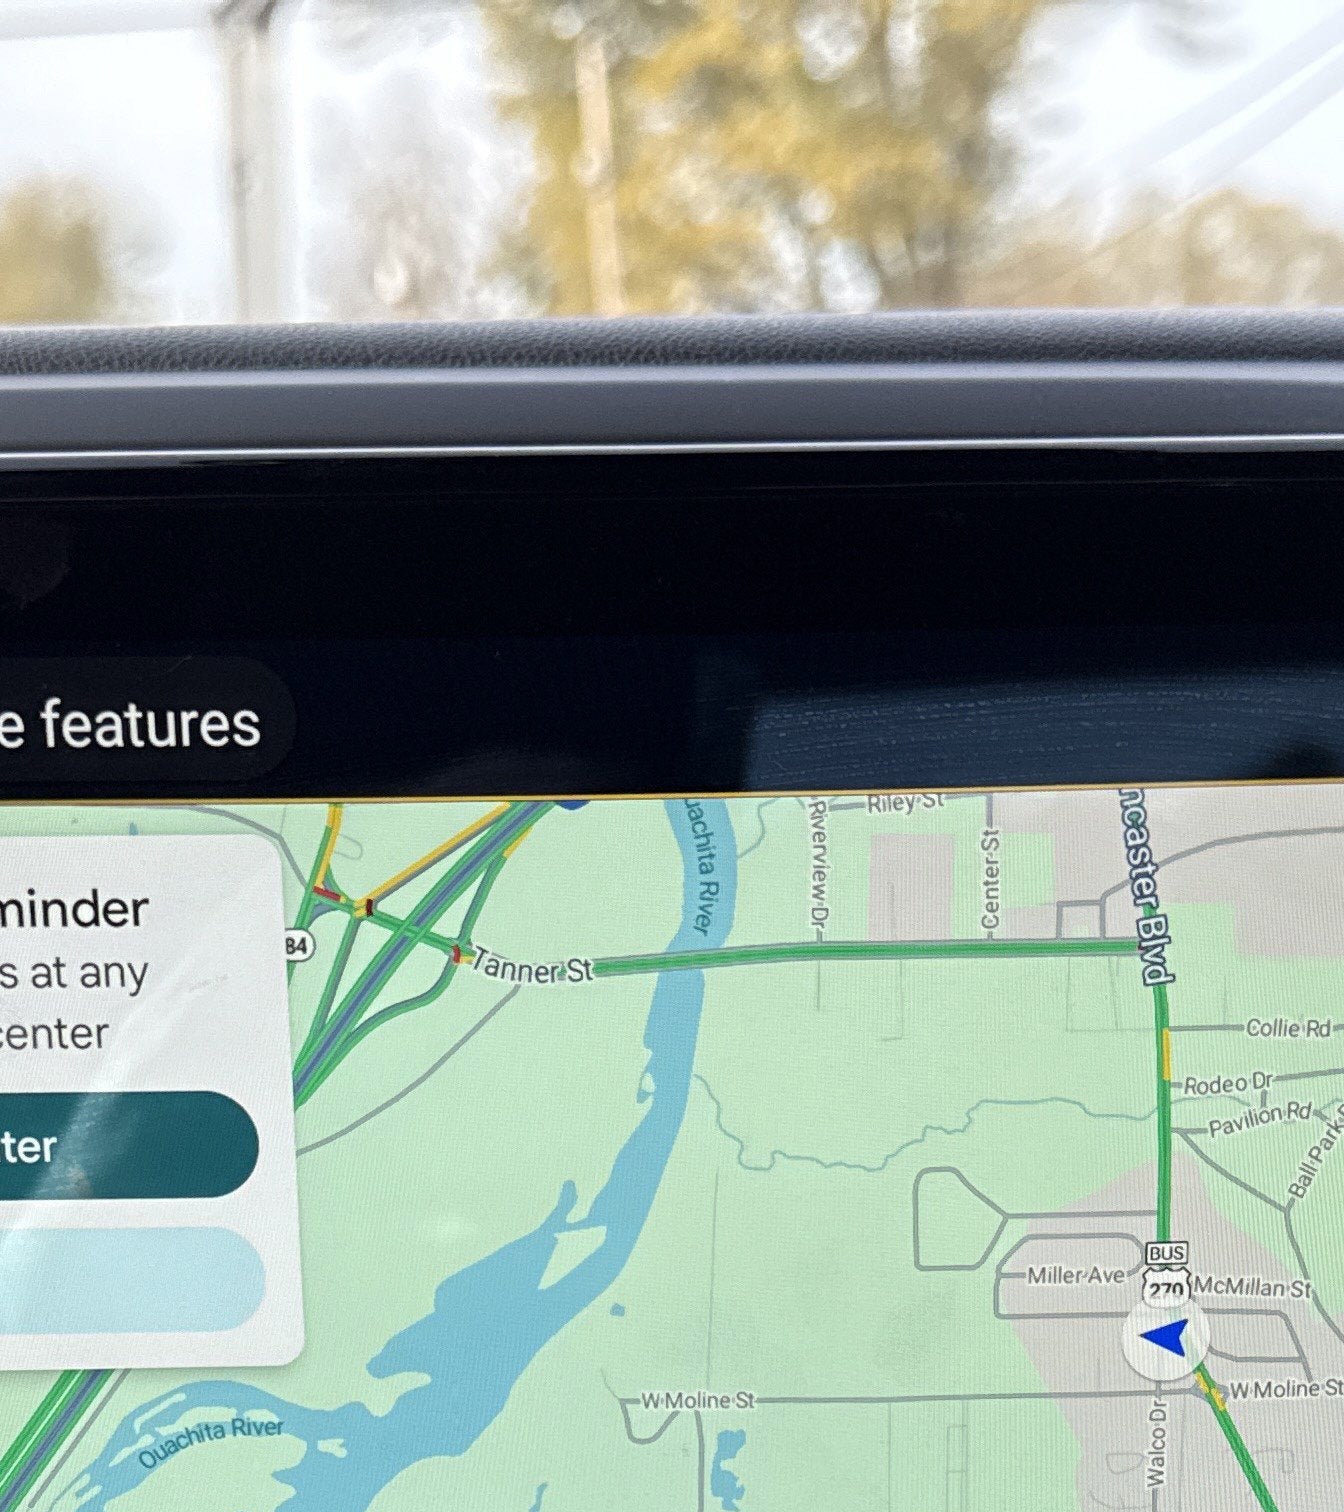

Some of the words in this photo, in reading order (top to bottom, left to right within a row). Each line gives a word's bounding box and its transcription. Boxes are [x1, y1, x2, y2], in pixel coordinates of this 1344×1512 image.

[39, 696, 262, 750] features
[868, 794, 916, 815] Riley
[922, 794, 944, 808] St
[809, 801, 830, 902] Riverview
[982, 829, 1000, 853] St
[981, 854, 1000, 930] Center
[694, 881, 720, 937] River
[812, 907, 829, 929] Dr
[1137, 914, 1176, 986] Blvd
[472, 946, 559, 984] Tanner
[566, 958, 594, 983] St
[30, 957, 68, 990] at
[78, 960, 150, 1001] any
[1246, 1018, 1300, 1038] Collie
[1306, 1018, 1331, 1038] Rd
[1184, 1074, 1246, 1095] Rodeo
[1252, 1071, 1273, 1090] Dr
[1209, 1102, 1283, 1138] Pavilion
[1286, 1101, 1313, 1120] Rd
[1288, 1162, 1318, 1200] Ball
[1149, 1245, 1185, 1261] BUS
[1027, 1266, 1081, 1286] Miller
[1087, 1267, 1126, 1285] Ave
[1194, 1275, 1285, 1298] McMillan
[1290, 1279, 1313, 1300] St
[1149, 1282, 1184, 1299] 270
[641, 1392, 662, 1410] W
[665, 1391, 731, 1410] Moline
[736, 1391, 756, 1409] St
[1229, 1382, 1250, 1400] W
[1254, 1380, 1321, 1399] Moline
[1149, 1401, 1167, 1423] Dr
[137, 1420, 228, 1471] Ouachita
[231, 1416, 285, 1441] River
[1146, 1426, 1167, 1487] Walco
